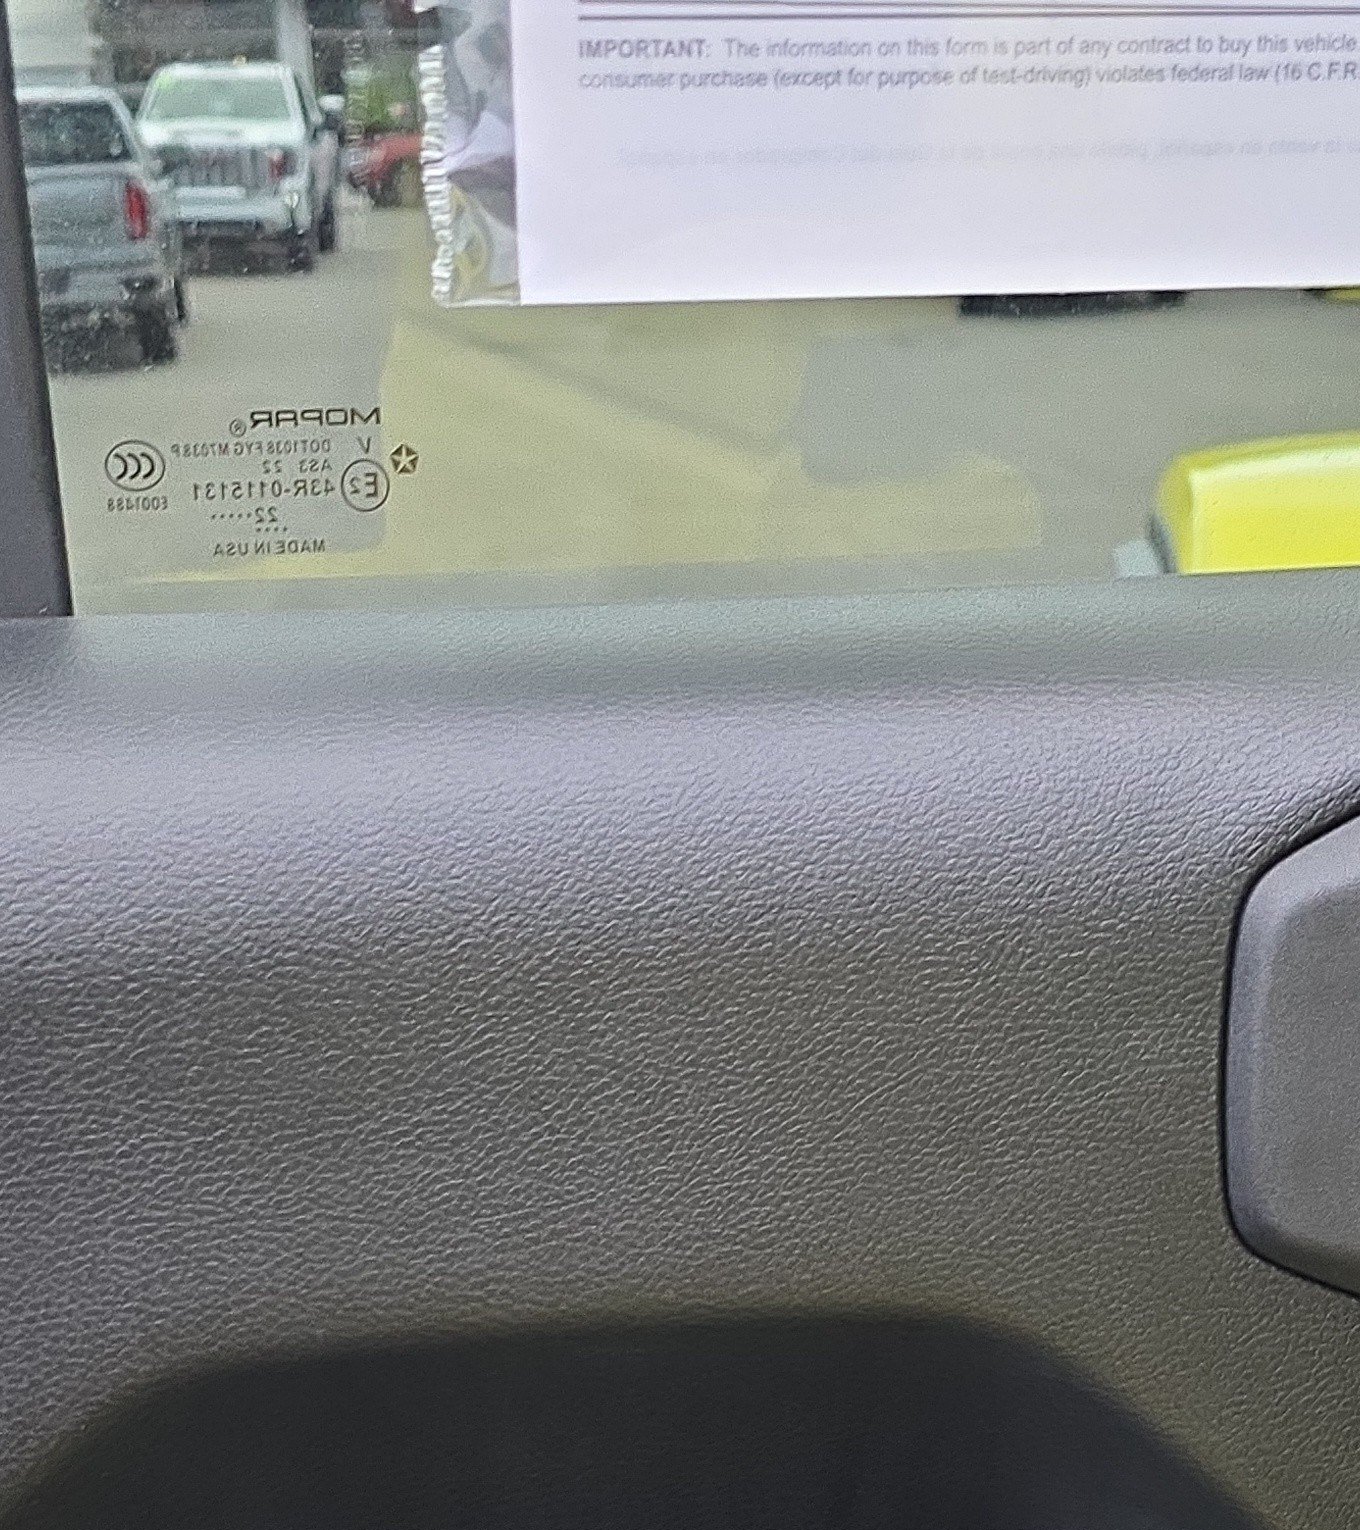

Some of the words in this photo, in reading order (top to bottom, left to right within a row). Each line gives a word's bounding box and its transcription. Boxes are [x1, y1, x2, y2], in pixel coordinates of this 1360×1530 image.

[578, 38, 711, 59] IMPORTANT:
[723, 38, 760, 58] The
[767, 38, 871, 58] information
[878, 41, 900, 57] on
[907, 38, 939, 56] this
[946, 37, 987, 55] form
[993, 39, 1007, 55] is
[1014, 38, 1051, 59] part
[1056, 36, 1075, 54] of
[1081, 40, 1111, 59] any
[1117, 36, 1190, 54] contract
[1197, 36, 1213, 53] to
[1219, 35, 1252, 57] buy
[1257, 34, 1288, 53] this
[579, 72, 674, 89] consumer
[680, 69, 767, 91] purchase
[773, 68, 842, 91] (except
[847, 66, 873, 86] for
[878, 70, 953, 90] purpose
[960, 66, 978, 85] of
[983, 65, 1090, 89] test-driving)
[1096, 64, 1165, 83] violates
[1171, 63, 1234, 83] federal
[1240, 63, 1268, 82] law
[1274, 61, 1303, 83] (16
